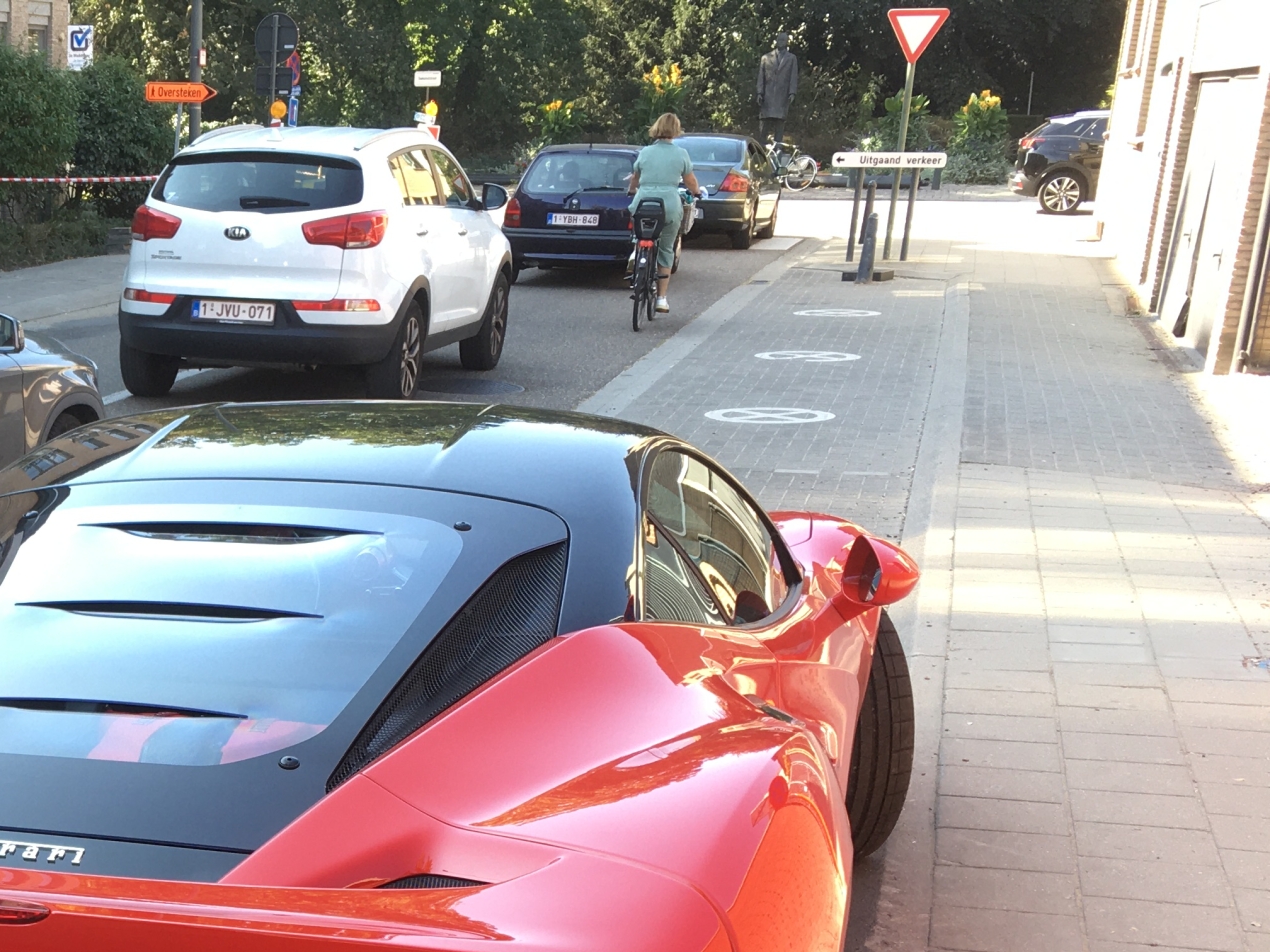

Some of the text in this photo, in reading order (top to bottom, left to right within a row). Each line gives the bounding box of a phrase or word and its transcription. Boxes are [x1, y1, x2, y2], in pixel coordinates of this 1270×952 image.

[158, 86, 202, 98] Oversteken
[859, 155, 942, 167] Uitgaand verkeer
[227, 227, 247, 238] KIA
[202, 302, 272, 320] 1-JVU-071
